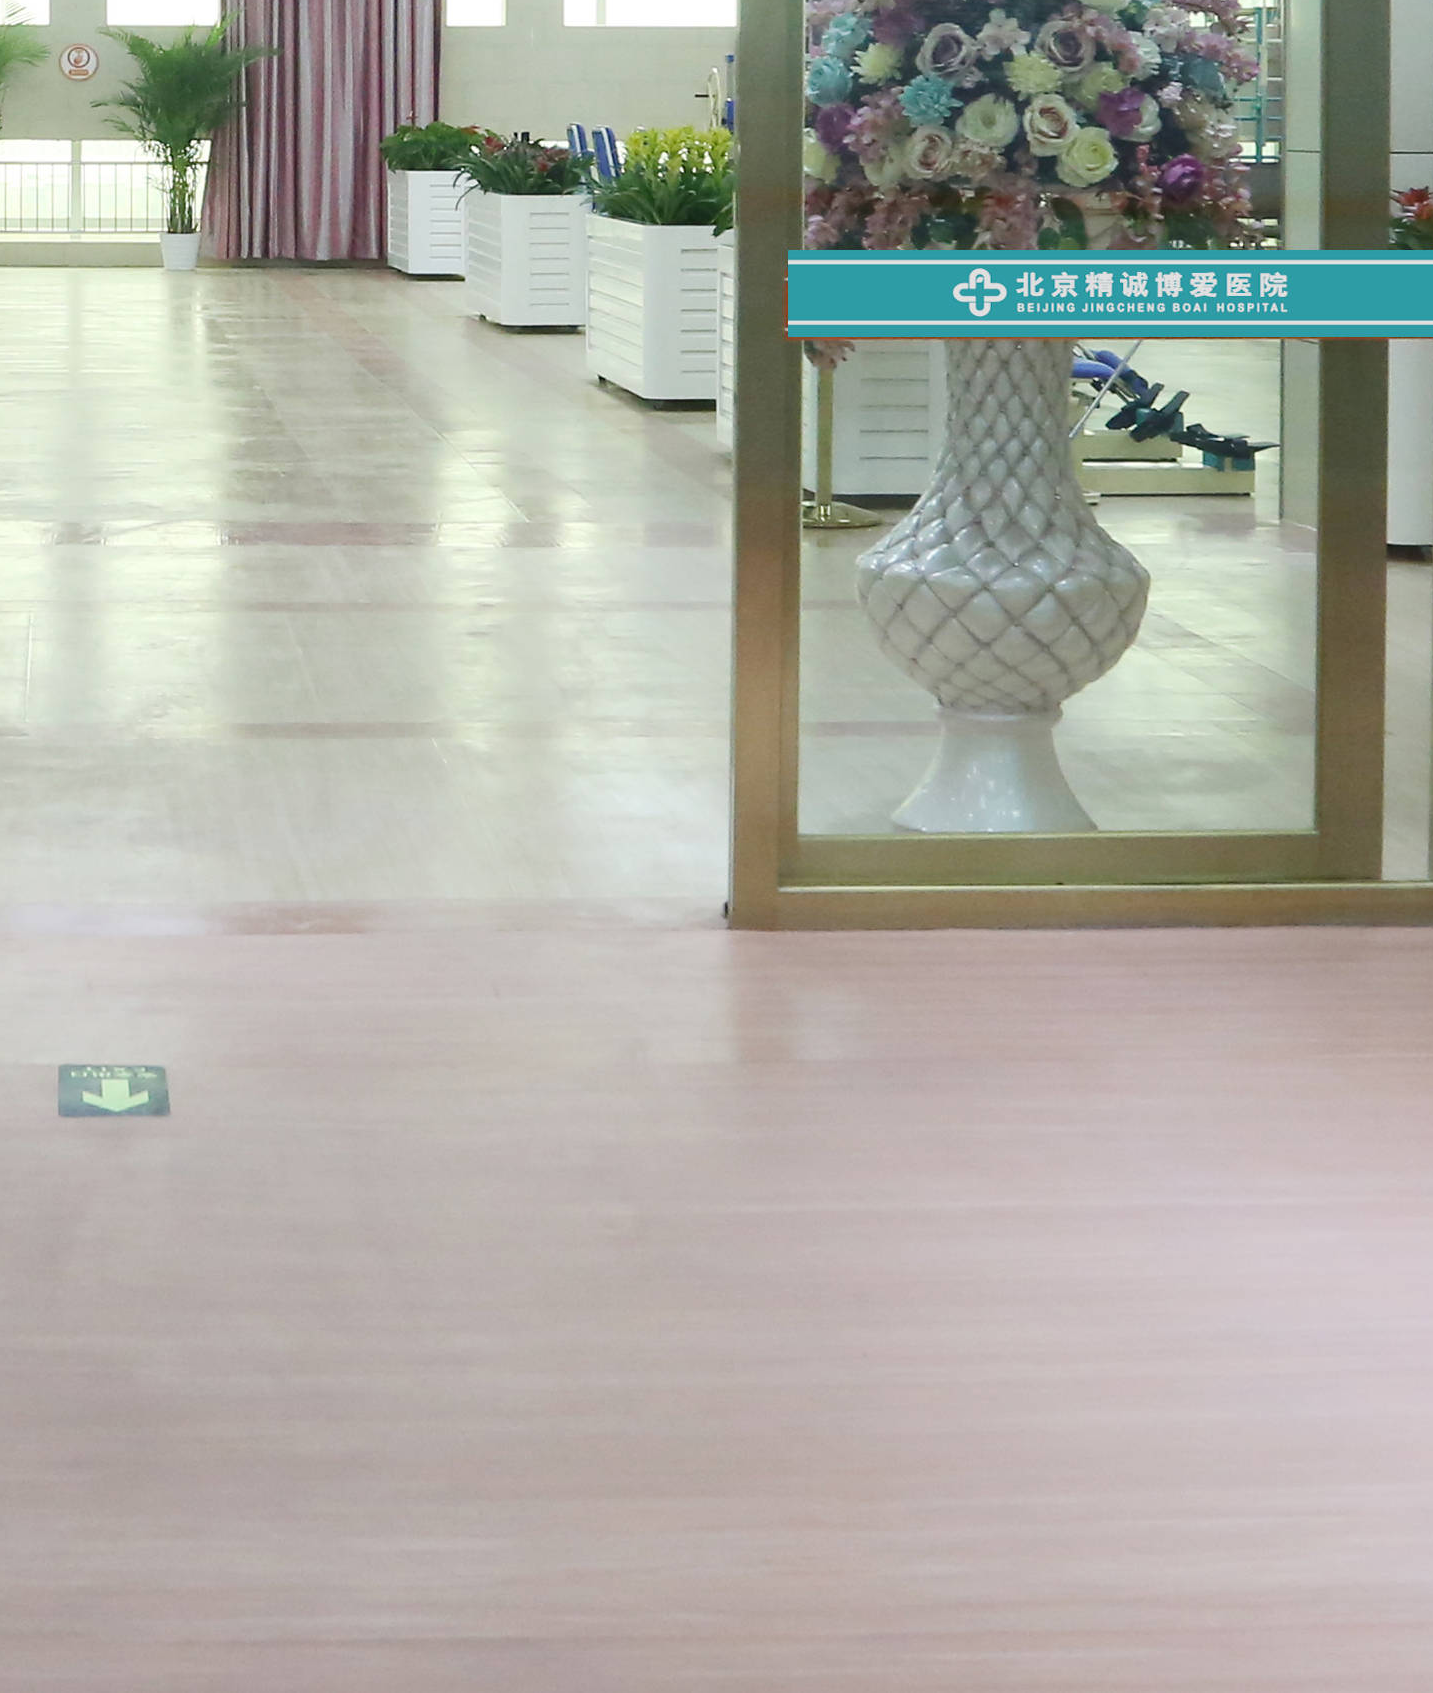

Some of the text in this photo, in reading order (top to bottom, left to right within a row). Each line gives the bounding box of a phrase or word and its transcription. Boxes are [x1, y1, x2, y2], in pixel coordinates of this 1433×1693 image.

[1016, 271, 1289, 298] 北京精诚博爱医院
[1017, 302, 1288, 313] BEIJING JINGCHENG BOAI HOSPITAL
